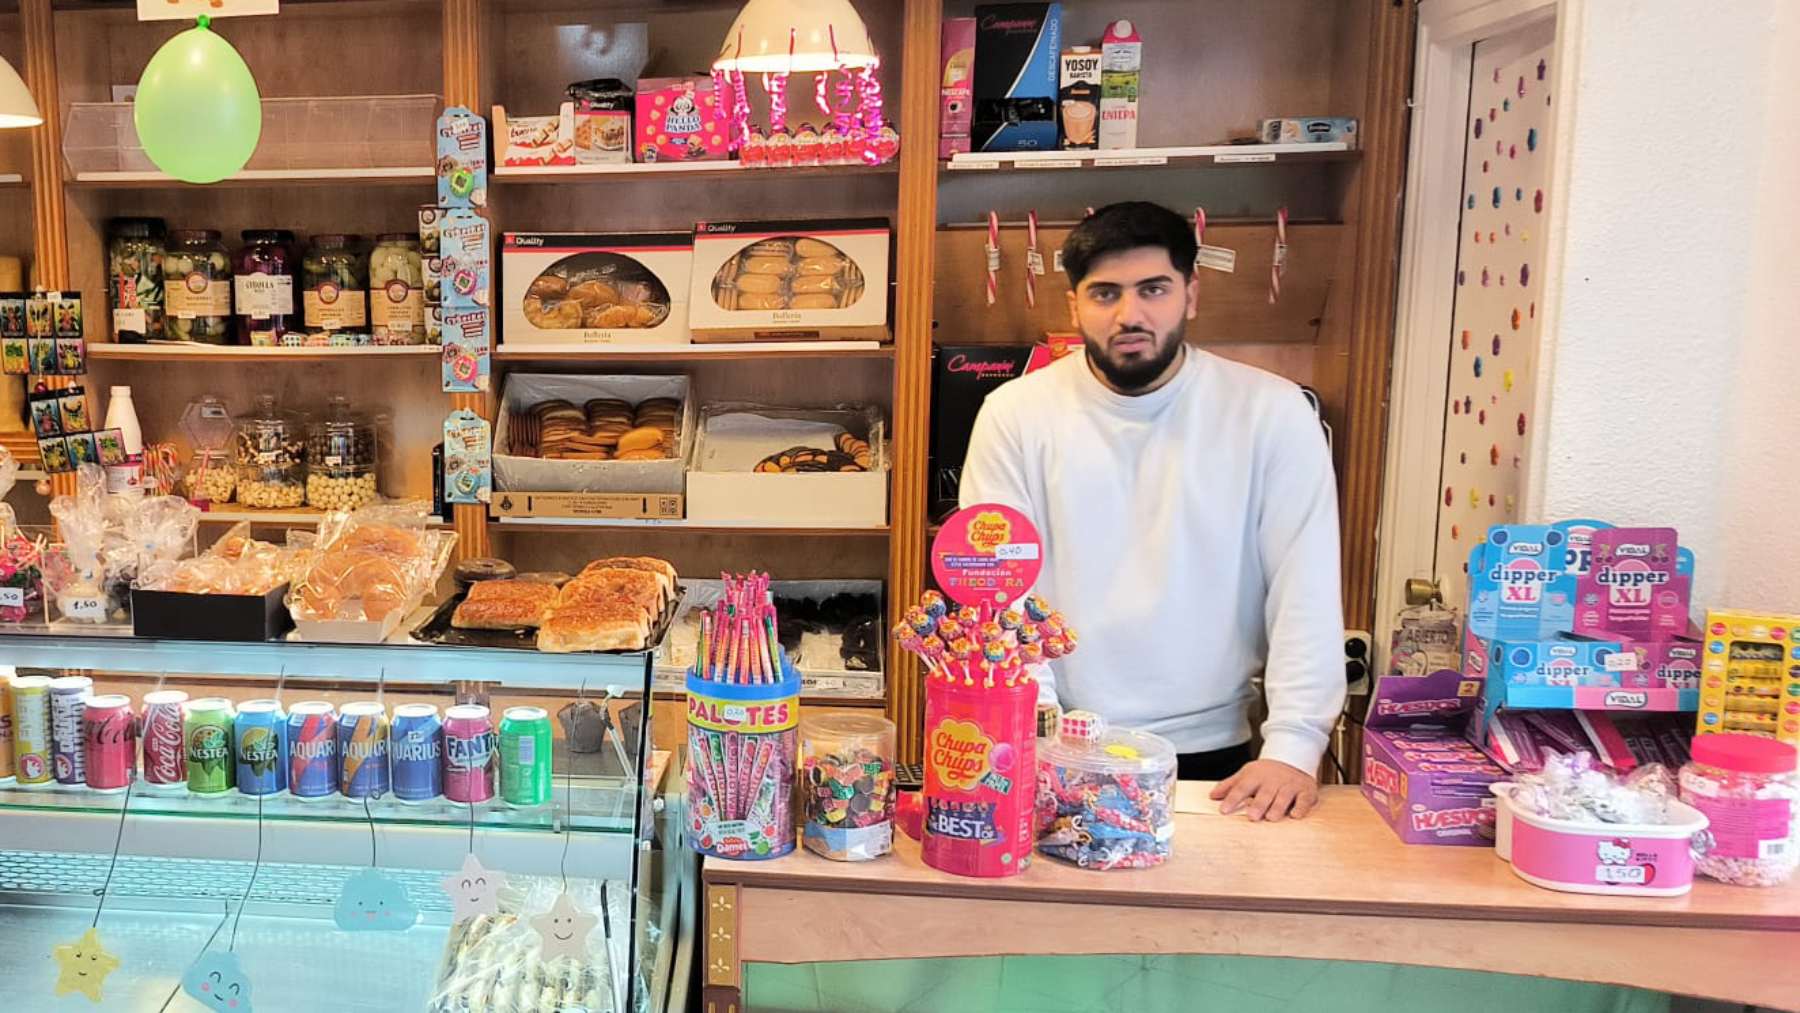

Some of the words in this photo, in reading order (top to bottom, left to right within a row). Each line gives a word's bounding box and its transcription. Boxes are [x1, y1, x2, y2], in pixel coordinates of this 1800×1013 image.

[1065, 59, 1099, 72] YOSOY
[708, 225, 736, 233] Quality
[516, 237, 545, 247] Quality
[1490, 564, 1557, 584] dipper
[1597, 566, 1667, 587] dipper
[1507, 587, 1536, 601] XL
[1615, 588, 1647, 602] XL
[1536, 663, 1589, 677] dipper
[936, 731, 988, 757] Chupa
[190, 746, 229, 759] NESTEA
[241, 749, 279, 761] NESTEA
[933, 749, 983, 780] Chups
[938, 813, 985, 839] BEST
